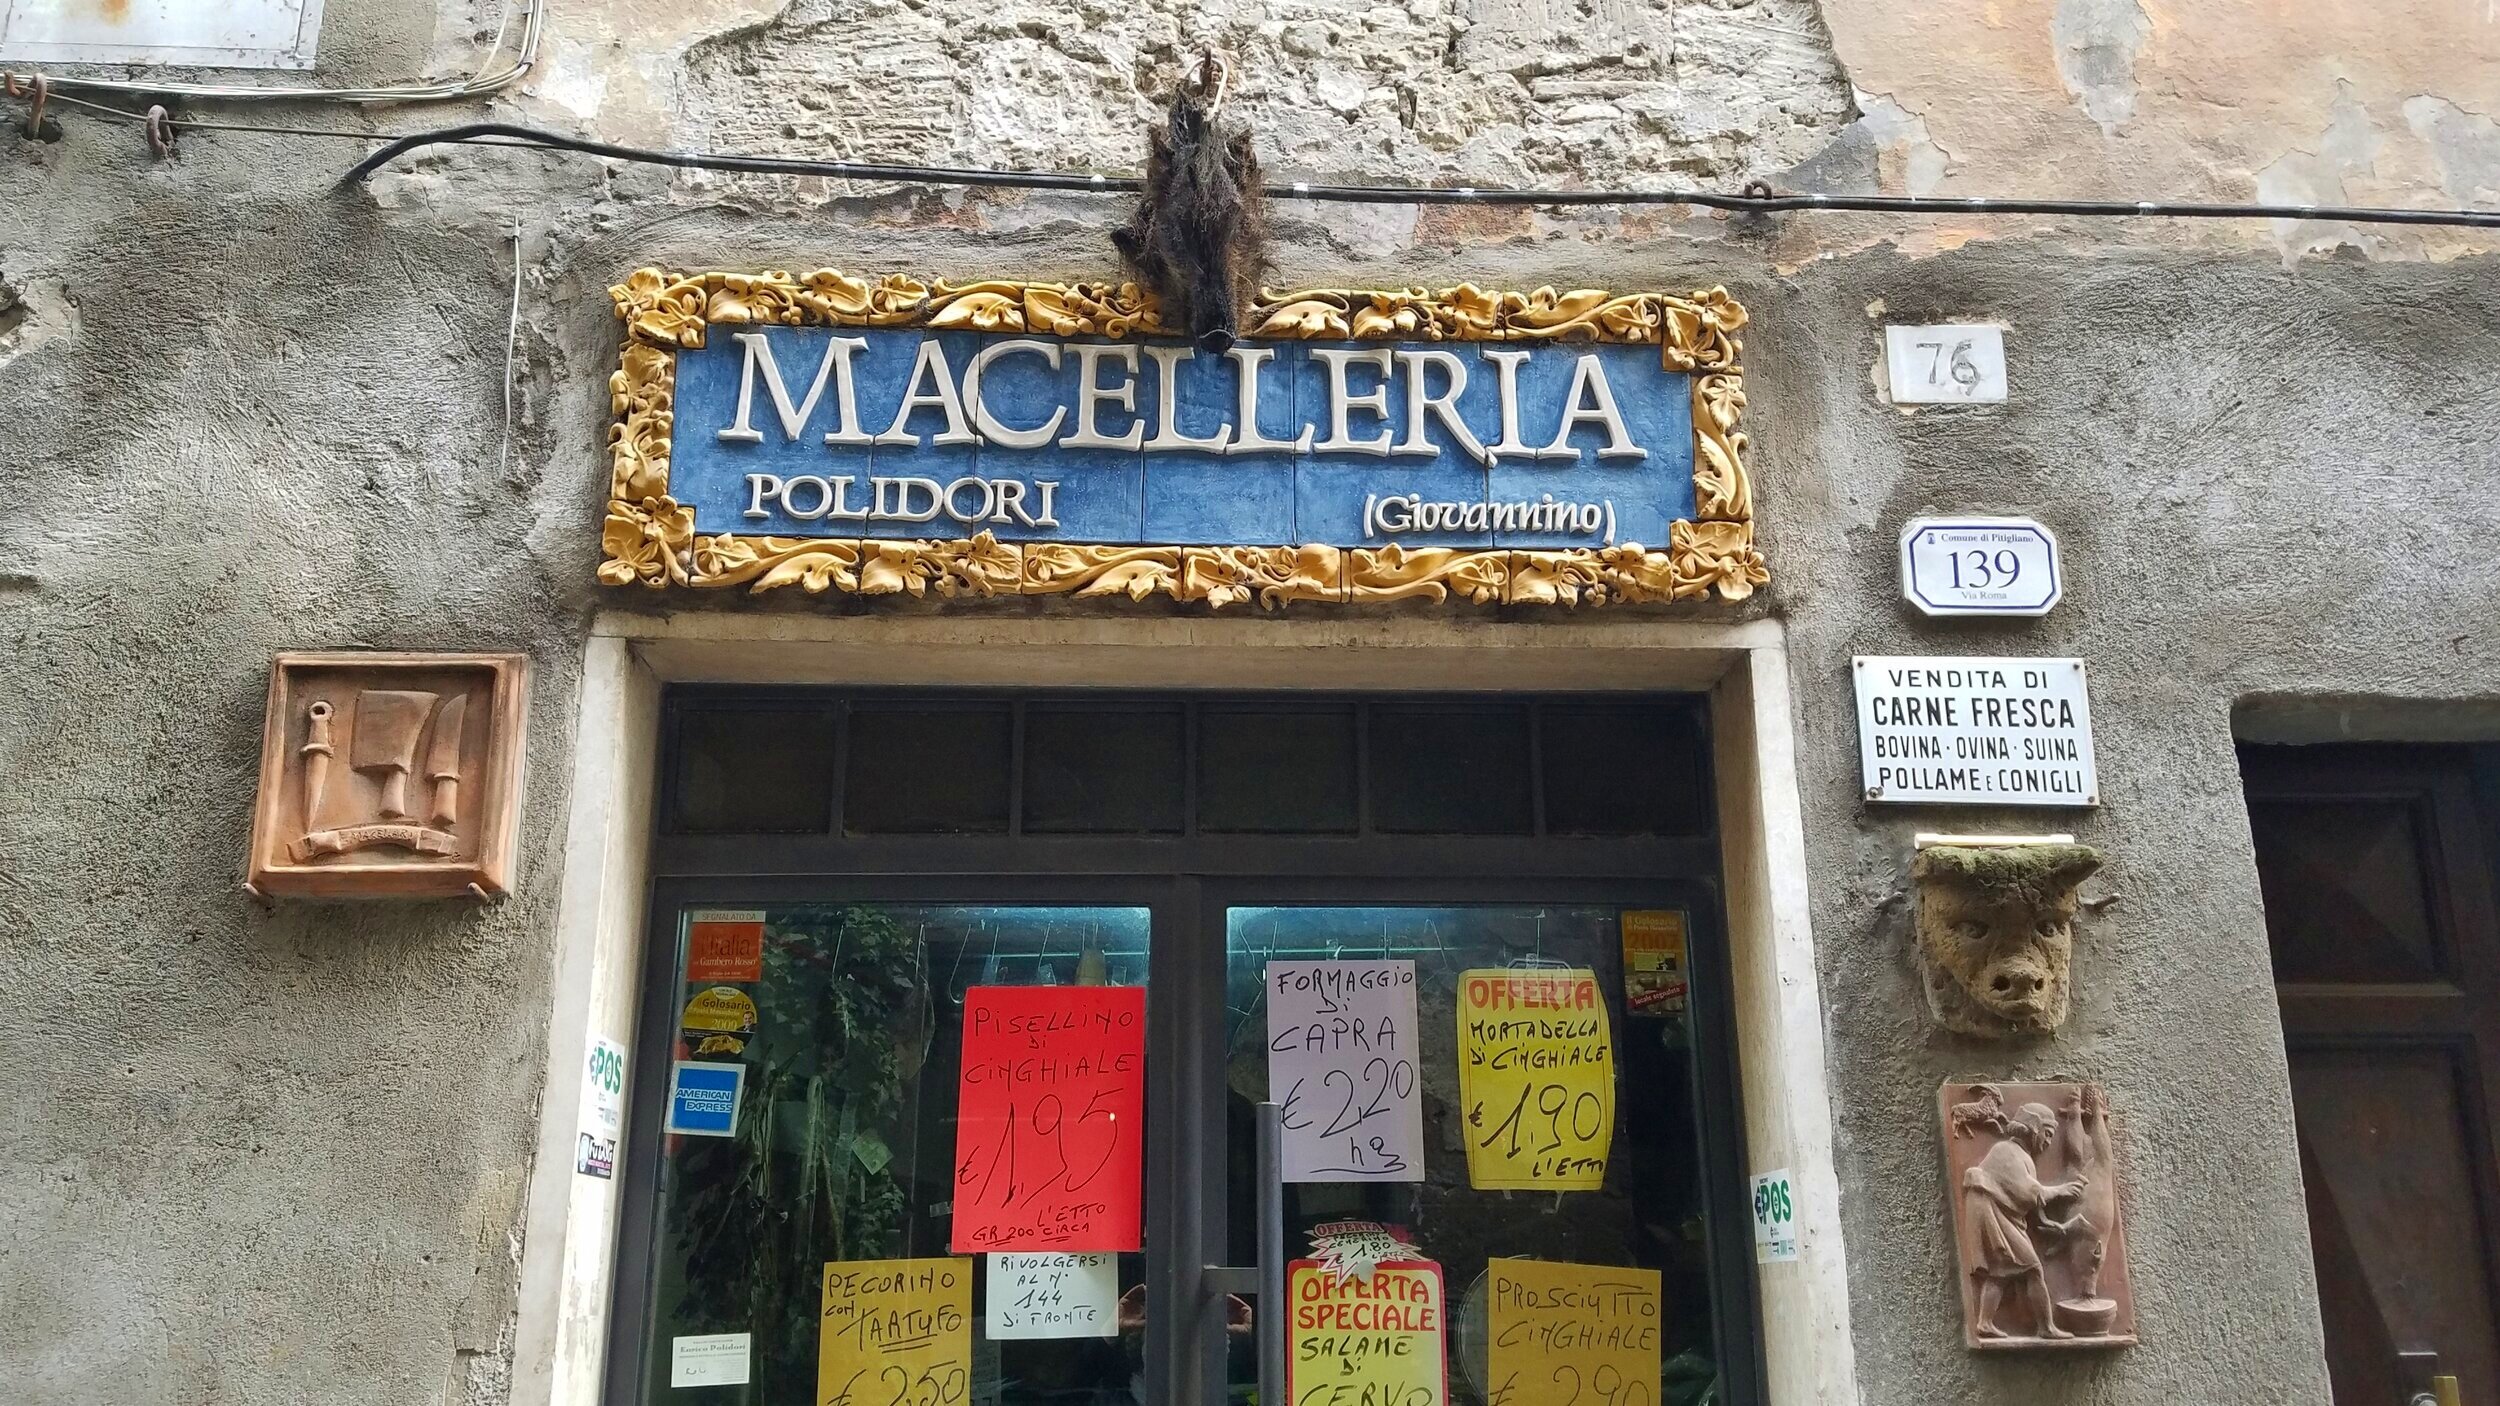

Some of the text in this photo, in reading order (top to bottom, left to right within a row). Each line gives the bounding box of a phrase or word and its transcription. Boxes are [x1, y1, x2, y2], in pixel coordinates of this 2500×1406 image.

[1915, 339, 1982, 396] 76
[717, 332, 1647, 467] MACELLERIA
[743, 474, 1059, 527] POLIDORI
[1363, 494, 1616, 545] (Giovannino)
[1941, 532, 2034, 543] Comune di Pitigliano
[1947, 549, 2020, 589] 139
[1961, 591, 2007, 599] Via Roma
[1888, 669, 2048, 689] VENDITA DI
[1873, 696, 2075, 729] CARNE FRESCA
[1875, 735, 2079, 762] BOVINA OVINA SUINA
[1878, 767, 1980, 791] POLLAME
[1998, 768, 2082, 793] CONIGLI
[745, 912, 757, 921] DA
[699, 956, 733, 966] Gambero
[702, 998, 751, 1011] Golosario
[1469, 980, 1594, 1012] OFFERTA
[1271, 1016, 1396, 1053] CAPRA
[1470, 1019, 1598, 1041] MORTADELLA
[676, 1088, 731, 1100] AMERICAN
[685, 1101, 732, 1113] EXPRESS
[1036, 1203, 1106, 1227] L'ETTO
[972, 1226, 999, 1241] GR
[1008, 1226, 1034, 1239] 200
[1315, 1221, 1382, 1236] OFFERTA
[829, 1267, 955, 1298] PECORINO
[1017, 1274, 1038, 1287] AL
[1301, 1273, 1430, 1304] OFFERTA
[1014, 1289, 1063, 1309] 144
[1030, 1305, 1097, 1325] FRONTE
[1297, 1303, 1436, 1332] SPECIALE
[837, 1304, 962, 1351] TARTUFO
[710, 1343, 746, 1352] Polidori
[1300, 1335, 1413, 1361] SALAME
